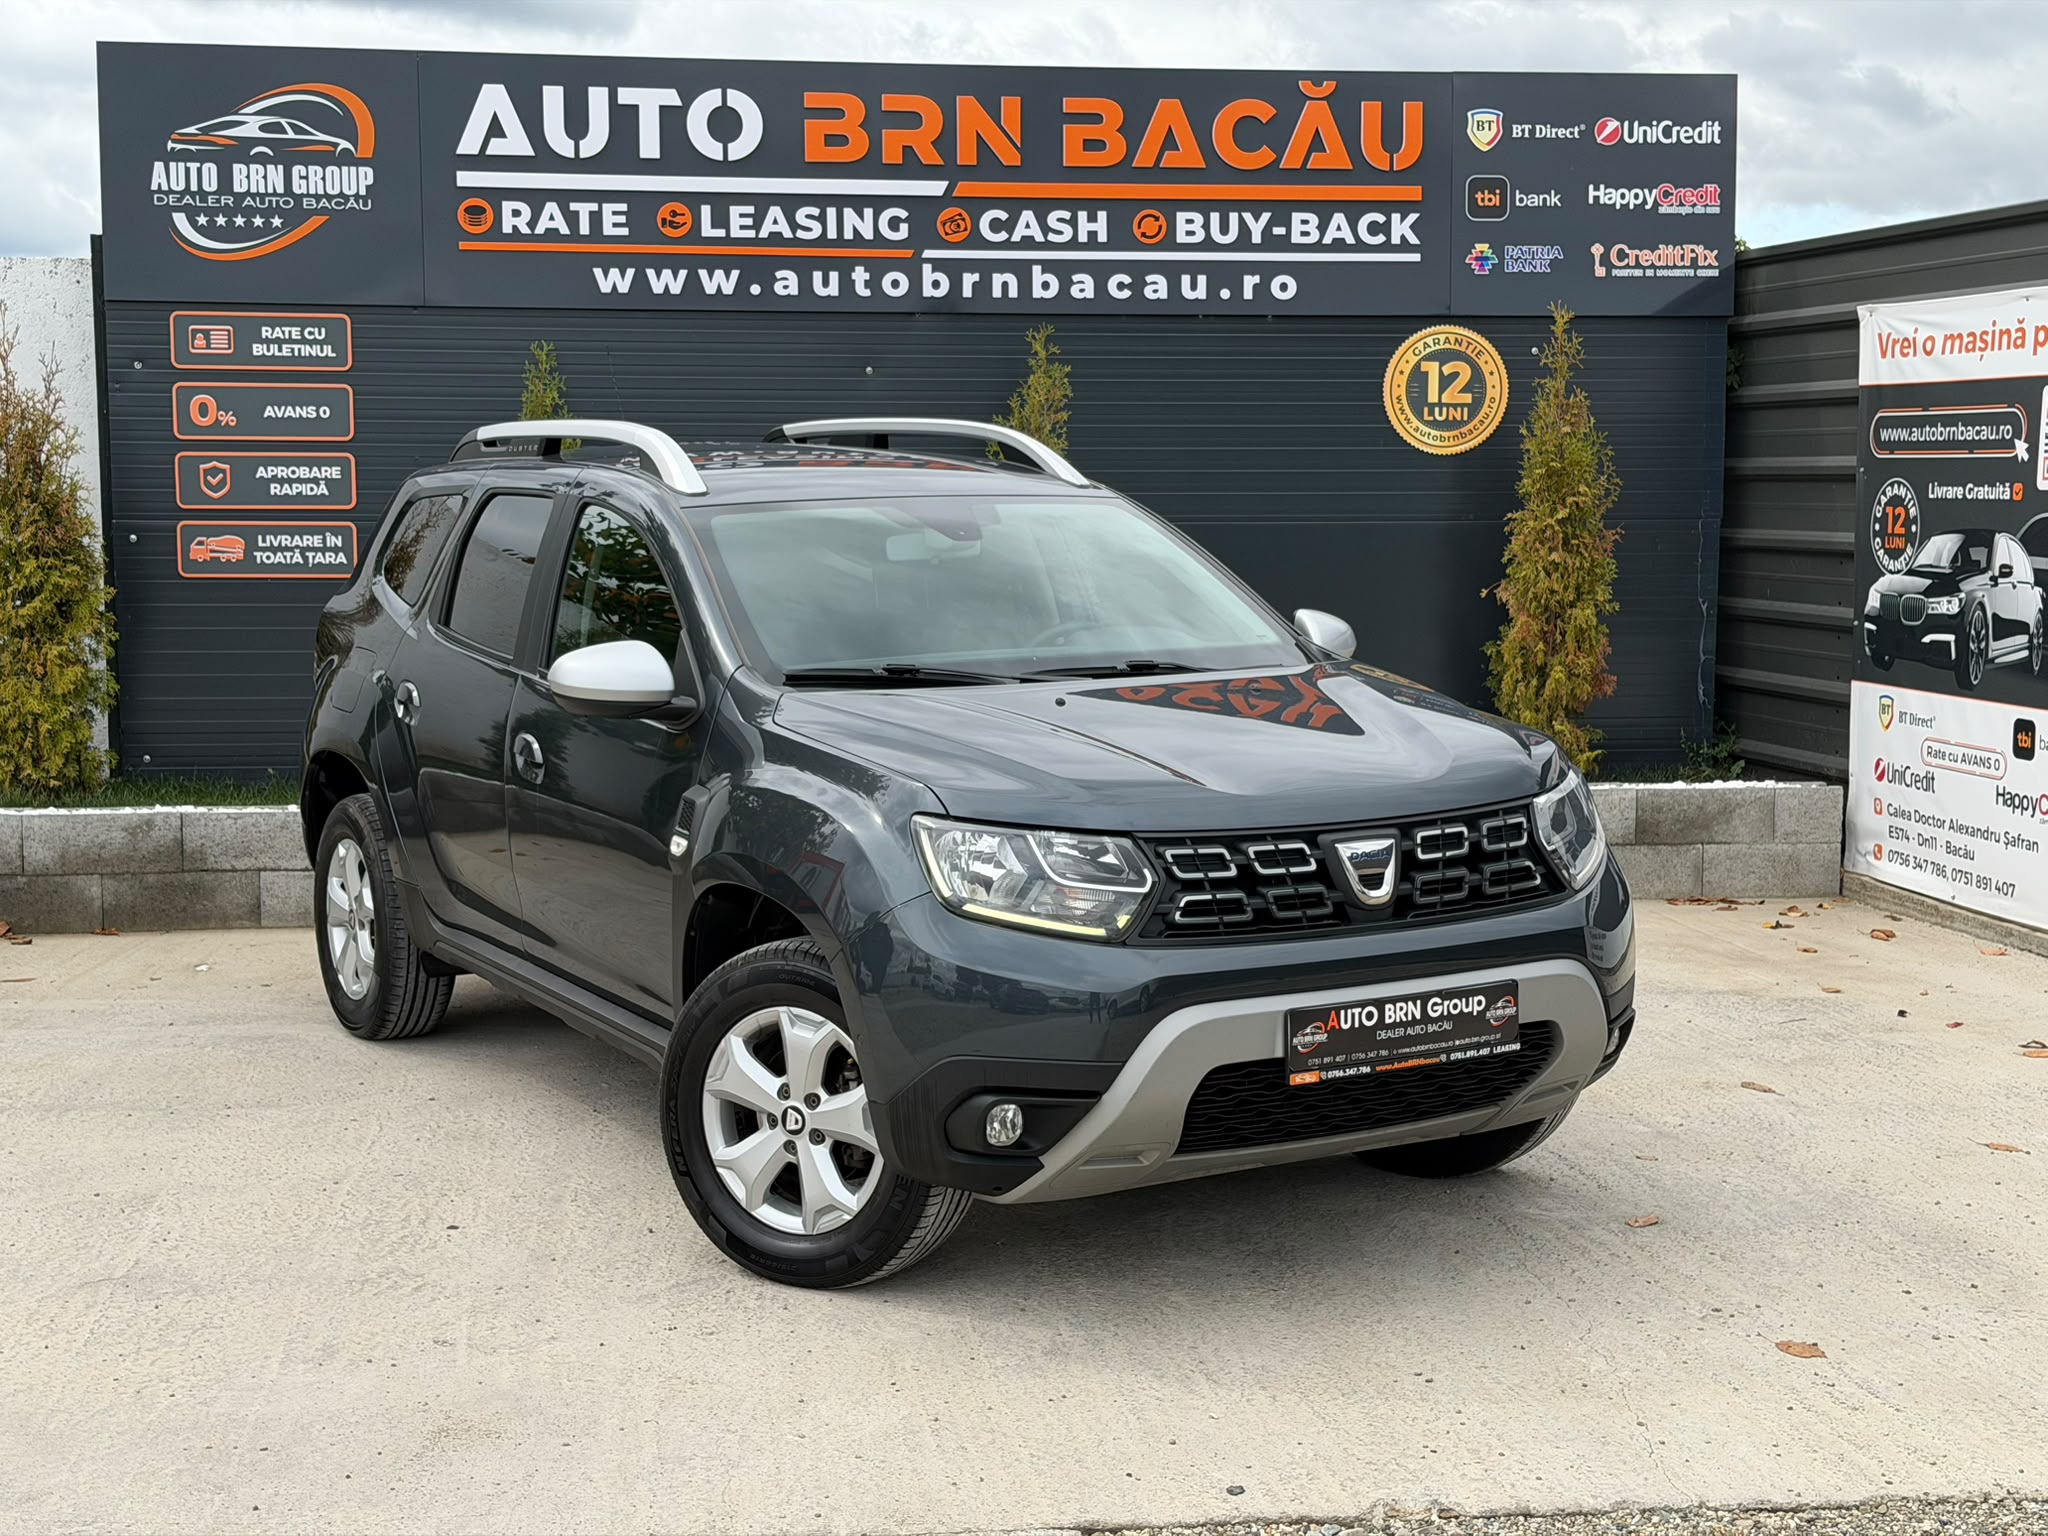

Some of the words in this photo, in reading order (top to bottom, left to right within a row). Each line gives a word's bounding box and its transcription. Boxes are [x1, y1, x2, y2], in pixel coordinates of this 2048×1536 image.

[455, 83, 764, 162] AUTO
[803, 91, 1021, 167] BRN
[1062, 80, 1424, 172] BACĂU
[1476, 119, 1495, 132] BT
[1511, 124, 1532, 138] BT
[1623, 119, 1721, 144] UniCredit
[151, 161, 218, 192] AUTO
[232, 163, 284, 194] BRN
[292, 165, 375, 196] GROUP
[153, 194, 234, 207] DEALER
[241, 196, 294, 209] AUTO
[303, 196, 372, 211] BACĂU
[1475, 188, 1501, 207] tbi
[1515, 189, 1562, 207] bank
[1588, 183, 1721, 210] HappyCredit
[501, 201, 630, 236] RATE
[700, 204, 910, 240] LEASING
[978, 209, 1108, 243] CASH
[1176, 211, 1421, 245] BUY-BACK
[1504, 245, 1564, 259] PATRIA
[1610, 243, 1719, 267] CreditFix
[1504, 259, 1551, 273] BANK
[592, 263, 1298, 301] www.autobrnbacau.ro
[261, 326, 302, 340] RATE
[304, 327, 326, 340] CU
[1877, 327, 1918, 359] Vrei
[1922, 335, 1936, 357] o
[1941, 317, 2026, 361] mașină
[2032, 324, 2048, 357] p
[252, 343, 336, 358] BULETINUL
[1412, 336, 1485, 360] GARANTIE
[1420, 361, 1472, 404] 12
[263, 405, 316, 419] AVANS
[319, 406, 331, 419] 0
[1395, 394, 1496, 443] www.autobrnbacau.ro
[1423, 407, 1468, 421] LUNI
[1879, 421, 2012, 442] www.autobrnbacau.ro
[255, 466, 342, 479] APROBARE
[269, 480, 329, 496] RAPIDĂ
[1928, 482, 1963, 499] Livrare
[1965, 482, 2011, 500] Gratuită
[1885, 506, 1906, 534] 12
[257, 534, 323, 548] LIVRARE
[326, 532, 342, 548] ÎN
[1885, 536, 1905, 549] LUNI
[253, 549, 303, 565] TOATĂ
[1881, 703, 1891, 716] BT
[1898, 710, 1908, 725] BT
[2016, 731, 2032, 749] tbi
[1926, 745, 1946, 761] Rate
[1948, 752, 1959, 763] cu
[1960, 752, 1992, 770] AVANS
[1993, 758, 2001, 772] 0
[1887, 761, 1936, 794] UniCredit
[1995, 784, 2048, 819] HappyC
[1886, 802, 1912, 821] Calea
[1914, 809, 1946, 830] Doctor
[1948, 818, 2000, 843] Alexandru
[1888, 825, 1910, 843] E574
[1917, 832, 1937, 851] Dn11
[1945, 840, 1975, 861] Bacău
[1888, 849, 1910, 867] 0756
[1912, 855, 1928, 873] 347
[1930, 861, 1949, 881] 786,
[1951, 867, 1973, 887] 0751
[1975, 874, 1992, 892] 891
[1994, 879, 2016, 898] 407
[1327, 1005, 1378, 1031] AUTO
[1384, 999, 1421, 1024] BRN
[1427, 994, 1486, 1019] Group
[1376, 1027, 1405, 1040] DEALER
[1406, 1024, 1426, 1036] AUTO
[1427, 1020, 1453, 1033] BACĂU
[1351, 1052, 1366, 1061] 0756
[1366, 1050, 1378, 1058] 347
[1378, 1049, 1389, 1057] 786
[1493, 1042, 1521, 1054] LEASING
